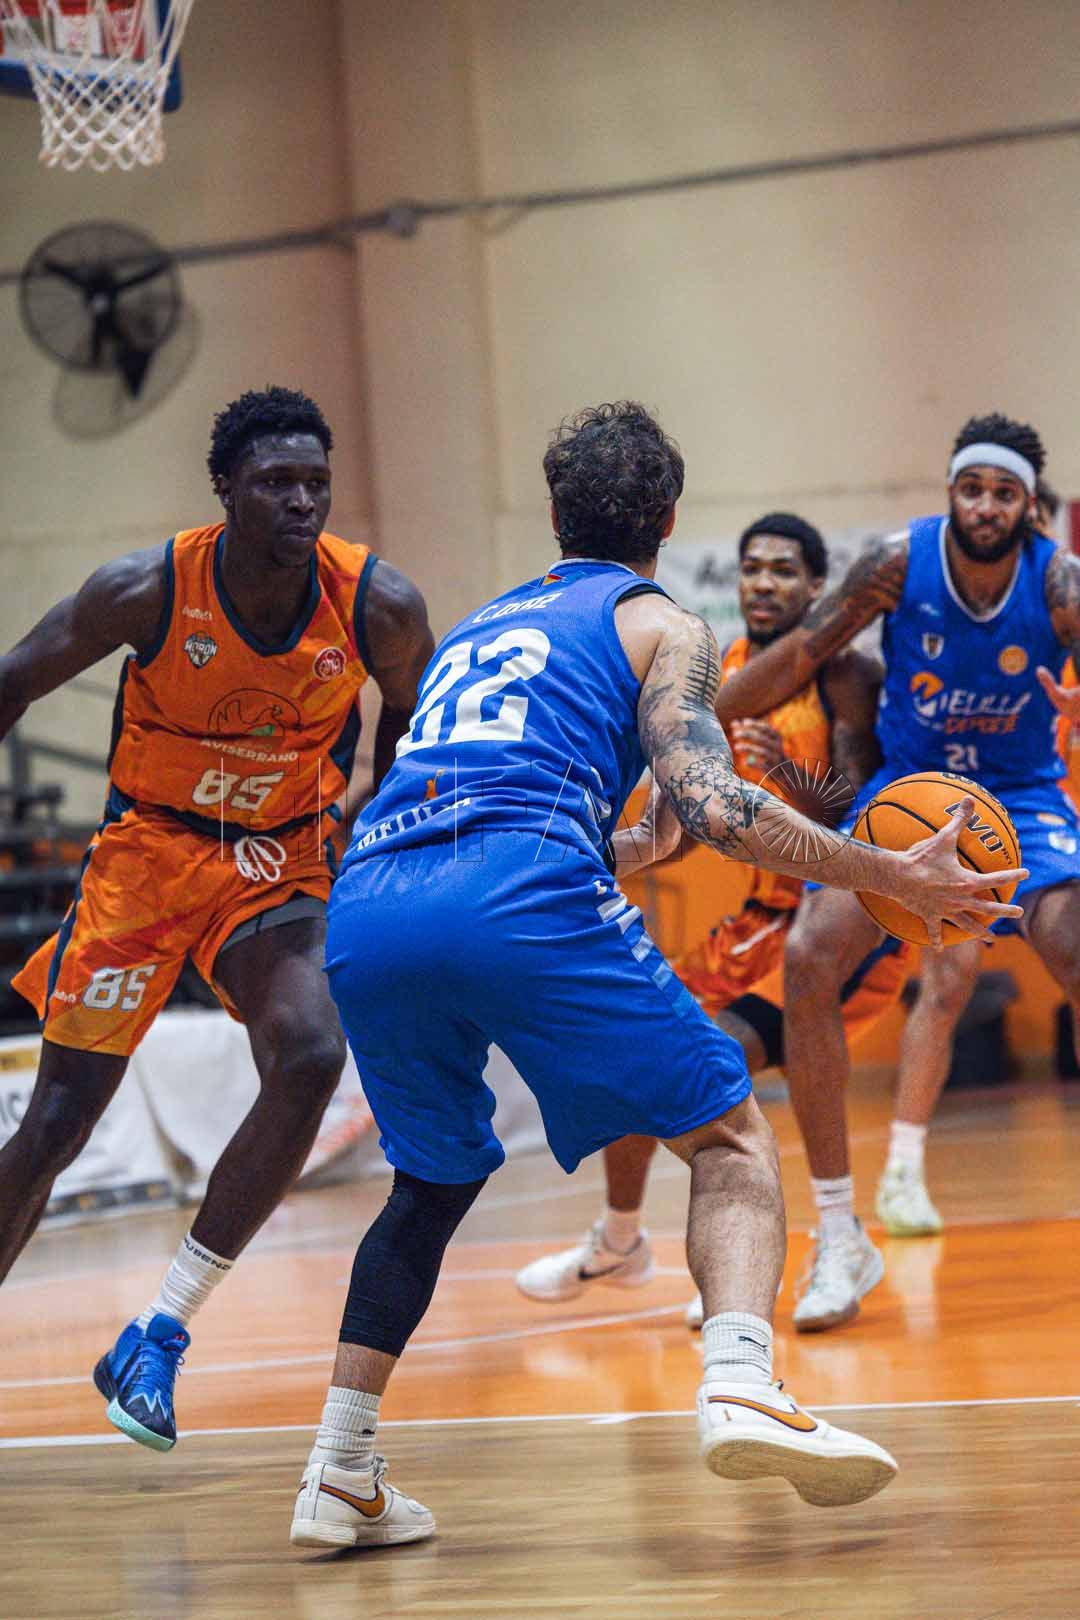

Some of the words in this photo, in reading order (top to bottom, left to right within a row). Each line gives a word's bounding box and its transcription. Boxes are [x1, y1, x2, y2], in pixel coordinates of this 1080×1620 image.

[396, 628, 550, 758] 22
[944, 743, 979, 771] 21
[192, 768, 285, 812] 85
[82, 964, 158, 1012] 85
